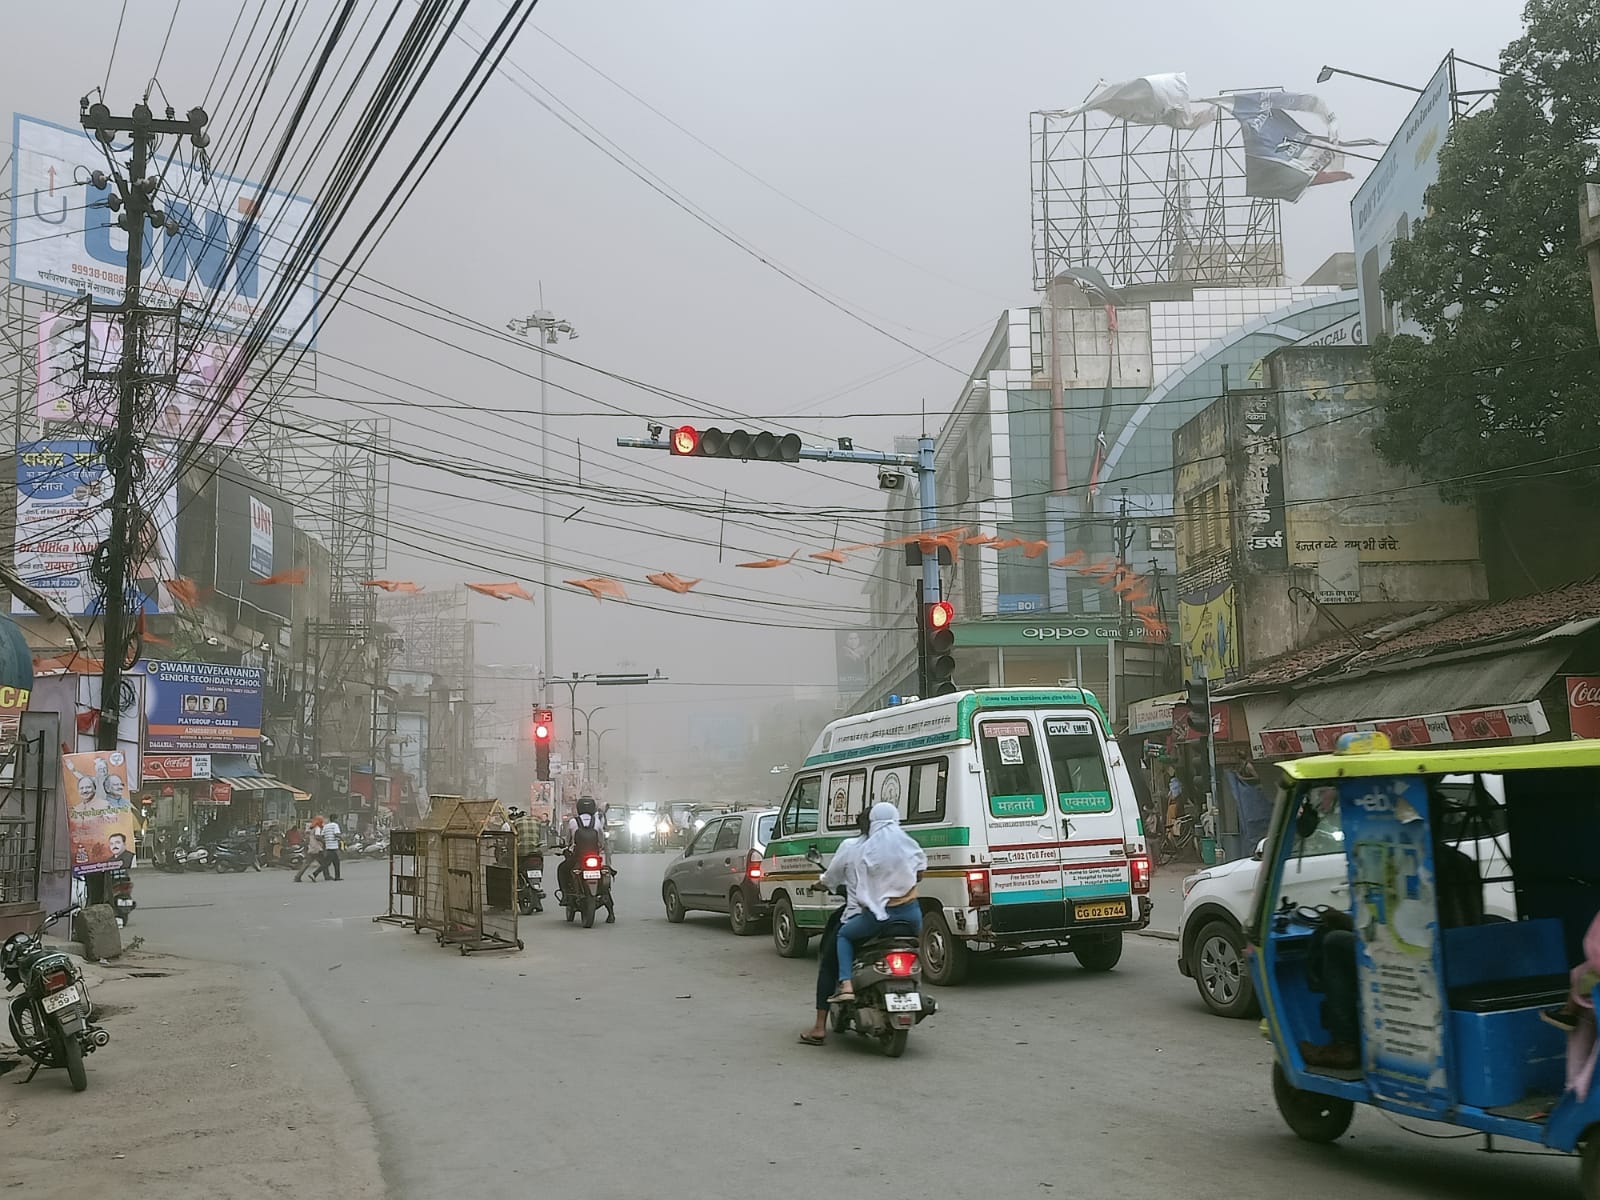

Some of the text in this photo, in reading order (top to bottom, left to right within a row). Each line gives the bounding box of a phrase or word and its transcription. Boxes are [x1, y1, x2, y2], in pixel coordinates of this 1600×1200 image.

[71, 263, 127, 285] 99938-0888
[1308, 328, 1347, 346] DICAL
[1362, 536, 1376, 550] भी
[1017, 601, 1035, 611] BOI
[1095, 626, 1134, 638] Cama
[160, 662, 261, 679] SWAMI VIVEKANANDA
[159, 673, 261, 688] SENIOR SECONDARY SCHOOL
[1049, 725, 1069, 734] GVK
[997, 798, 1036, 811] महतारी
[1077, 906, 1124, 918] CG 02 6744
